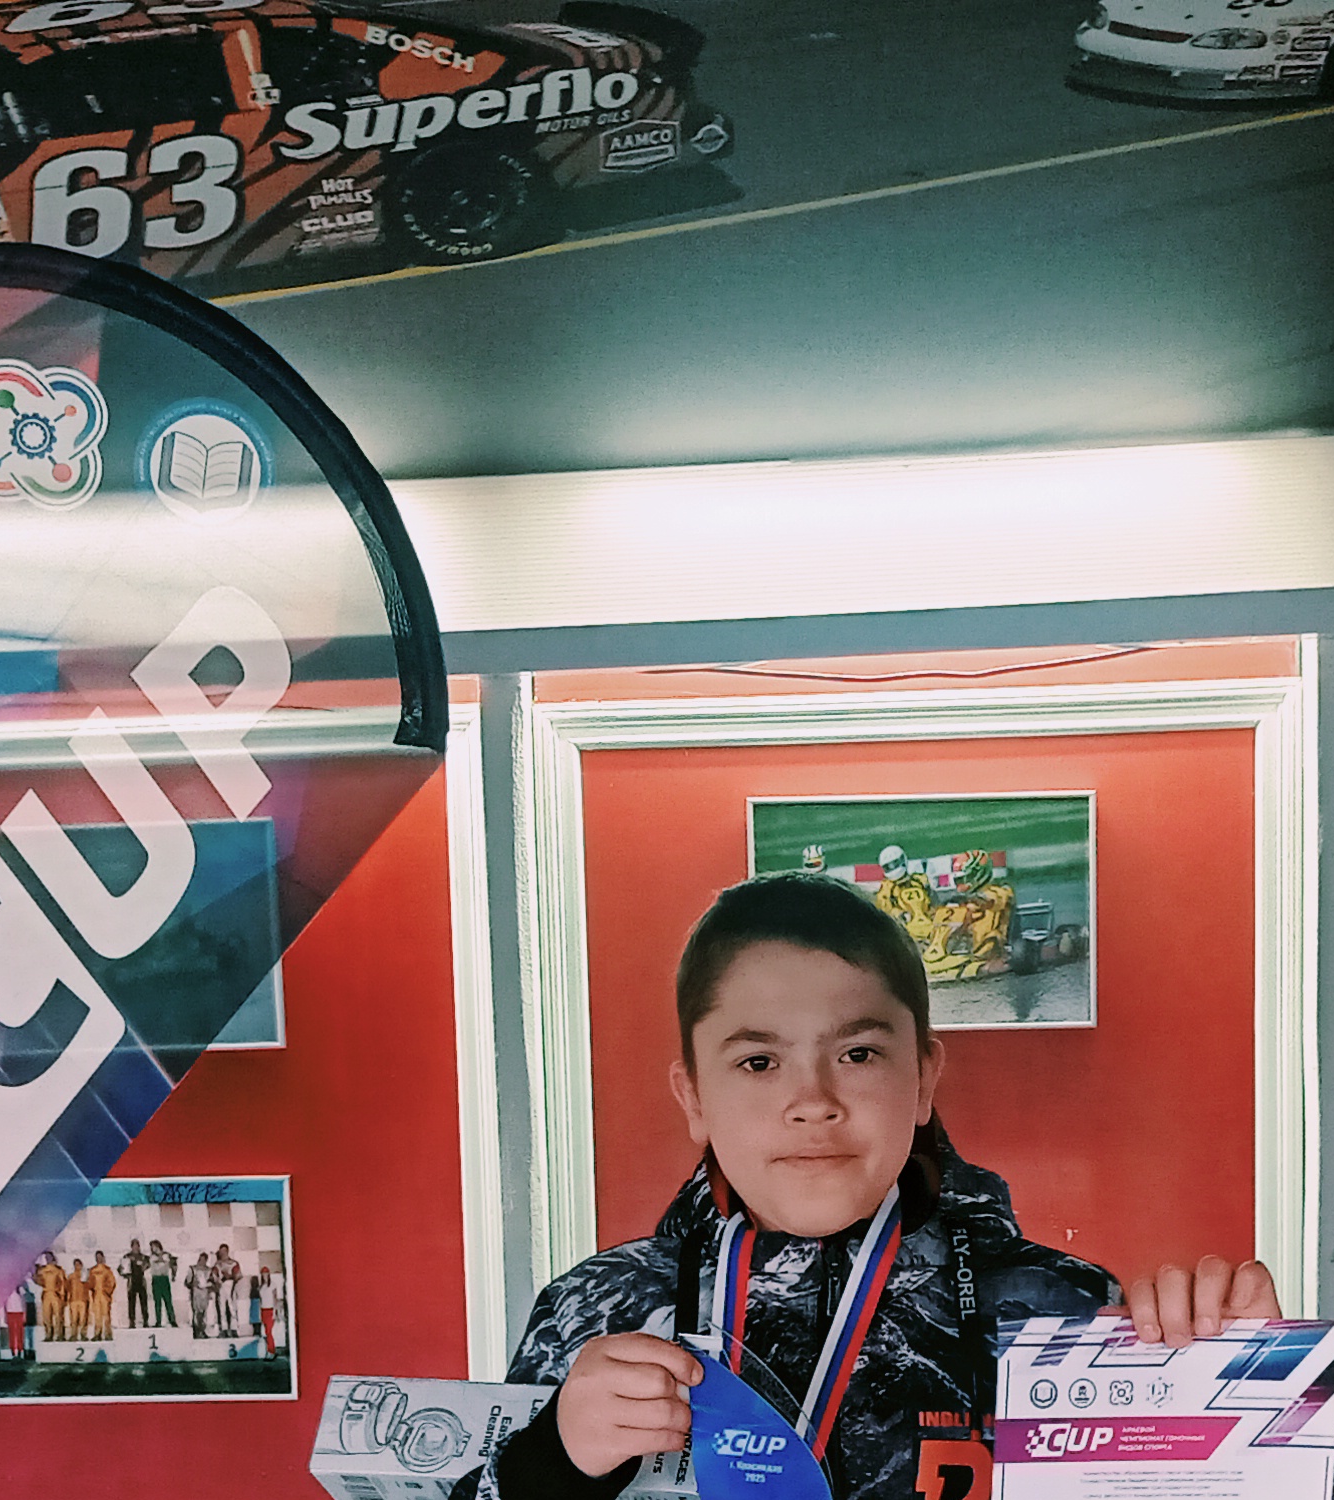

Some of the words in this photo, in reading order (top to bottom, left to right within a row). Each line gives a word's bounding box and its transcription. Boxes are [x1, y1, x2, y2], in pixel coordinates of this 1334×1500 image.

[364, 25, 475, 73] BOSCH
[610, 129, 673, 151] AAMCO
[321, 177, 355, 193] HOT
[31, 135, 240, 260] 63
[148, 1333, 159, 1350] 1
[229, 1343, 238, 1358] 3
[75, 1347, 85, 1362] 2
[478, 1405, 502, 1457] Cleaning
[497, 1416, 513, 1440] Eas
[1046, 1426, 1114, 1453] CUP
[729, 1432, 788, 1456] CUP
